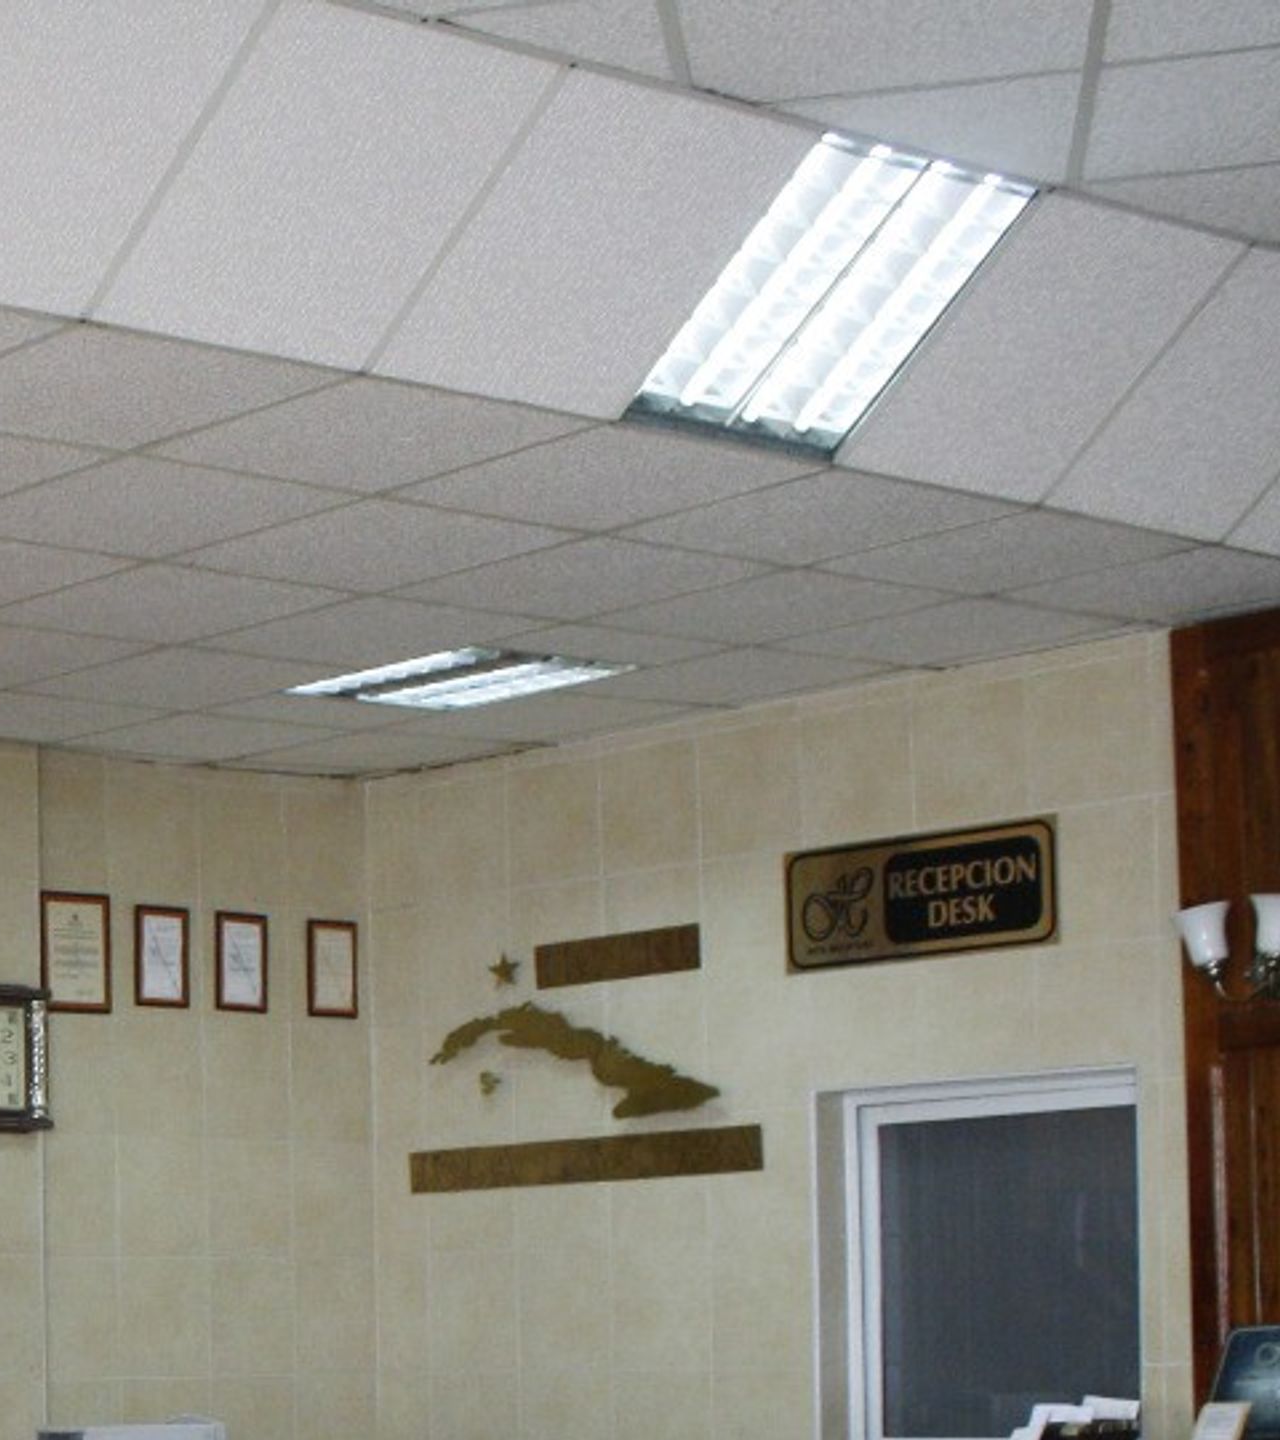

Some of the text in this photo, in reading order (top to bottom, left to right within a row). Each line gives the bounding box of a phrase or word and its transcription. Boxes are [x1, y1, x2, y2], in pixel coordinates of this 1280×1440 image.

[888, 853, 1037, 900] RECEPCION
[927, 893, 997, 929] DESK
[0, 1029, 14, 1044] 2
[3, 1050, 17, 1065] 3
